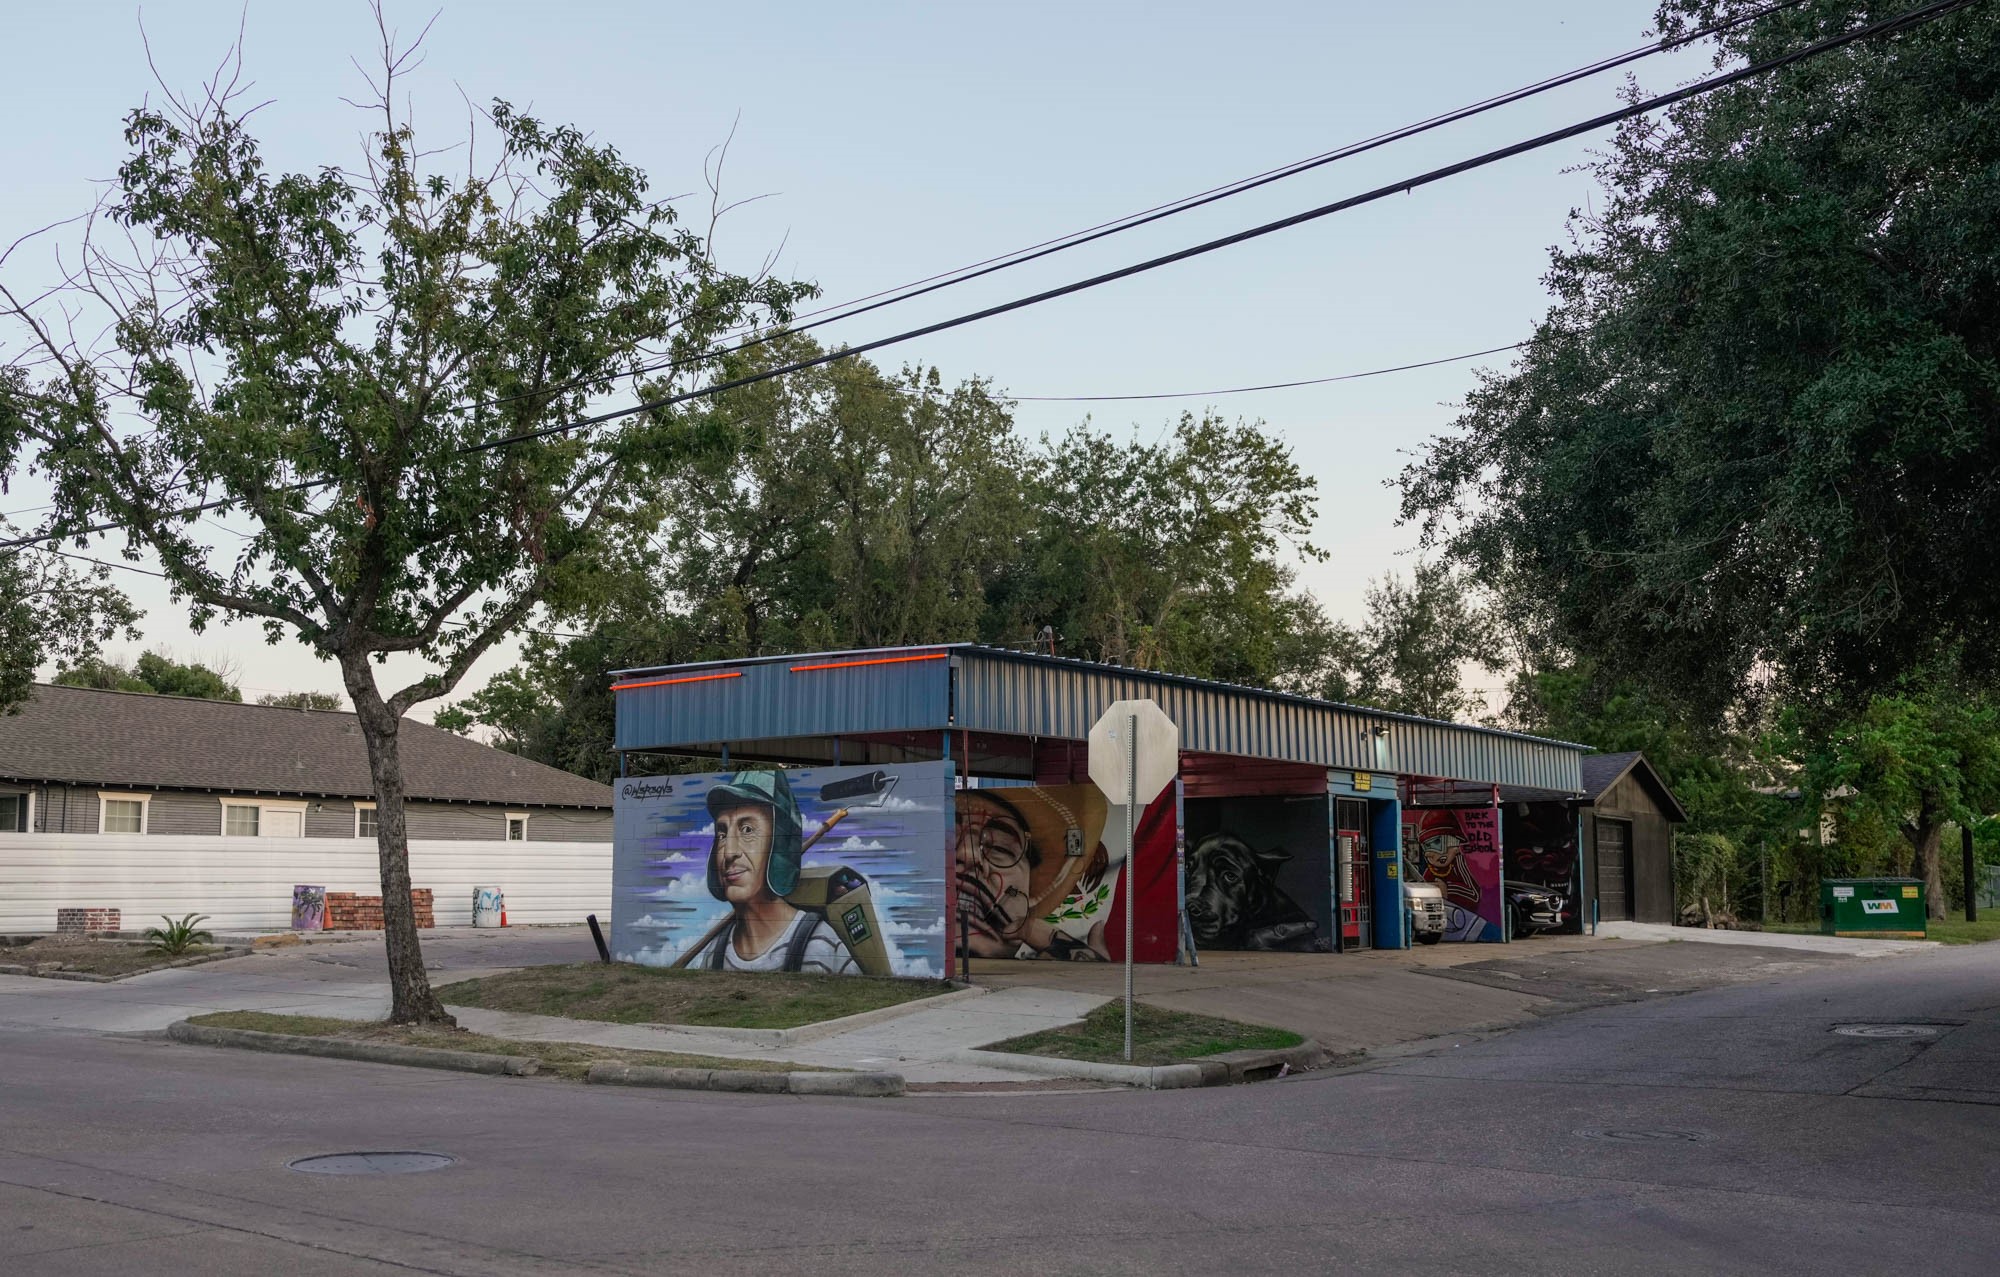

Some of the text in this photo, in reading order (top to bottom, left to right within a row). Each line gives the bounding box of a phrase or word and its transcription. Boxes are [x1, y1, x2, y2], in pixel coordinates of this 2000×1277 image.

[1465, 812, 1488, 820] BACK
[1468, 830, 1492, 841] OLD
[1463, 842, 1496, 853] SCHOOL
[1867, 902, 1893, 910] WM
